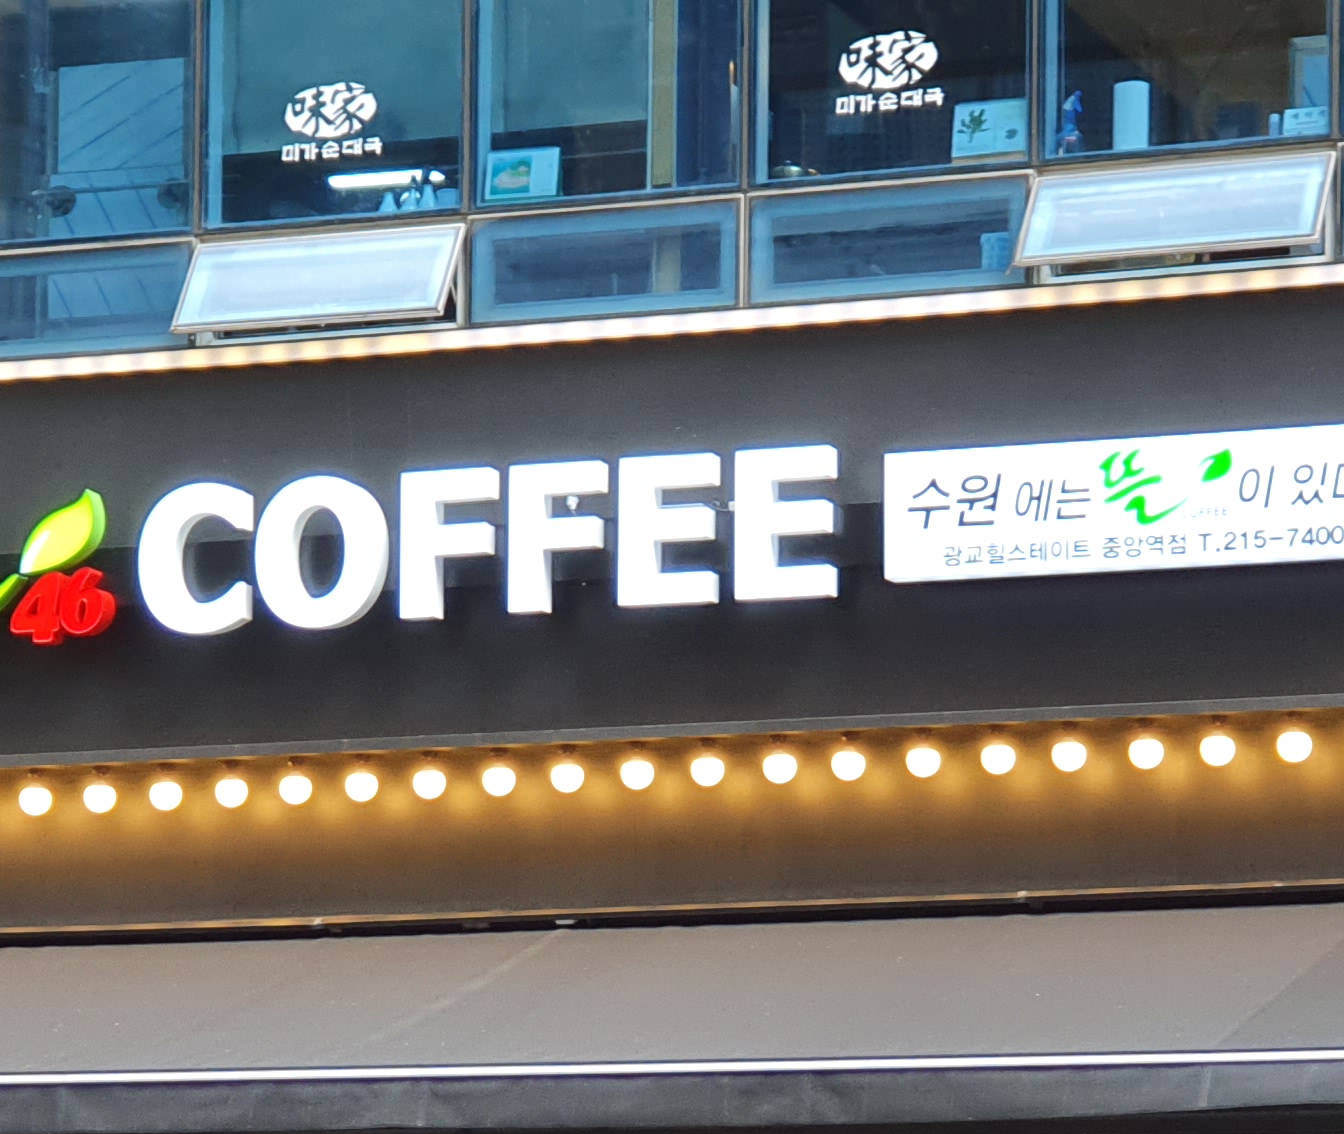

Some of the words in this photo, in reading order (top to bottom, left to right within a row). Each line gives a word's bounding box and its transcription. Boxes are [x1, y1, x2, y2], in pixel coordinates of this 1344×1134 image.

[835, 87, 945, 115] 미가순대국
[281, 136, 384, 162] 미가순대국
[907, 472, 1002, 529] 수원
[1014, 479, 1092, 522] 에는
[138, 444, 840, 636] COFFEE
[943, 539, 1092, 567] 광교힐스테이트
[1102, 535, 1187, 559] 중앙역점
[10, 567, 117, 645] 46
